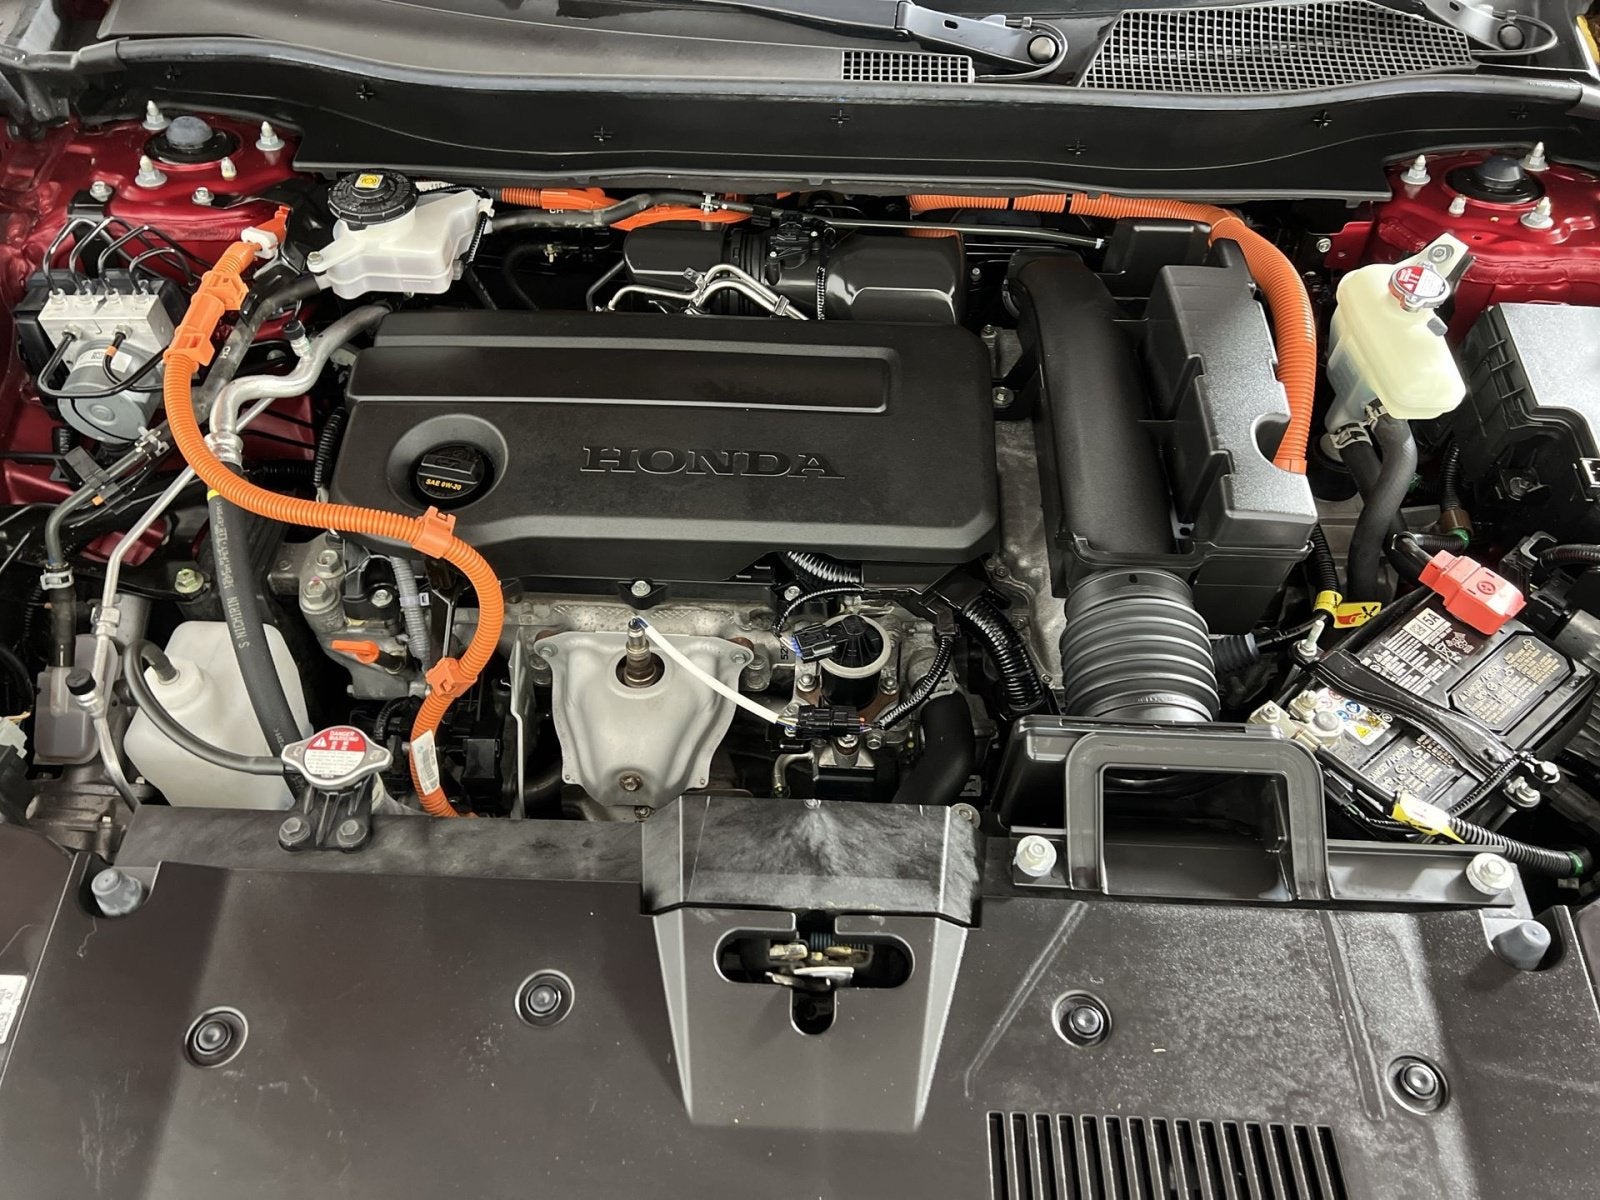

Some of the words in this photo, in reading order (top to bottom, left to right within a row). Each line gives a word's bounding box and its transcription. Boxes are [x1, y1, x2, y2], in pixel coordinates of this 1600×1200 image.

[580, 446, 846, 480] HONDA
[425, 479, 441, 487] SAE
[441, 482, 462, 491] 0W-20
